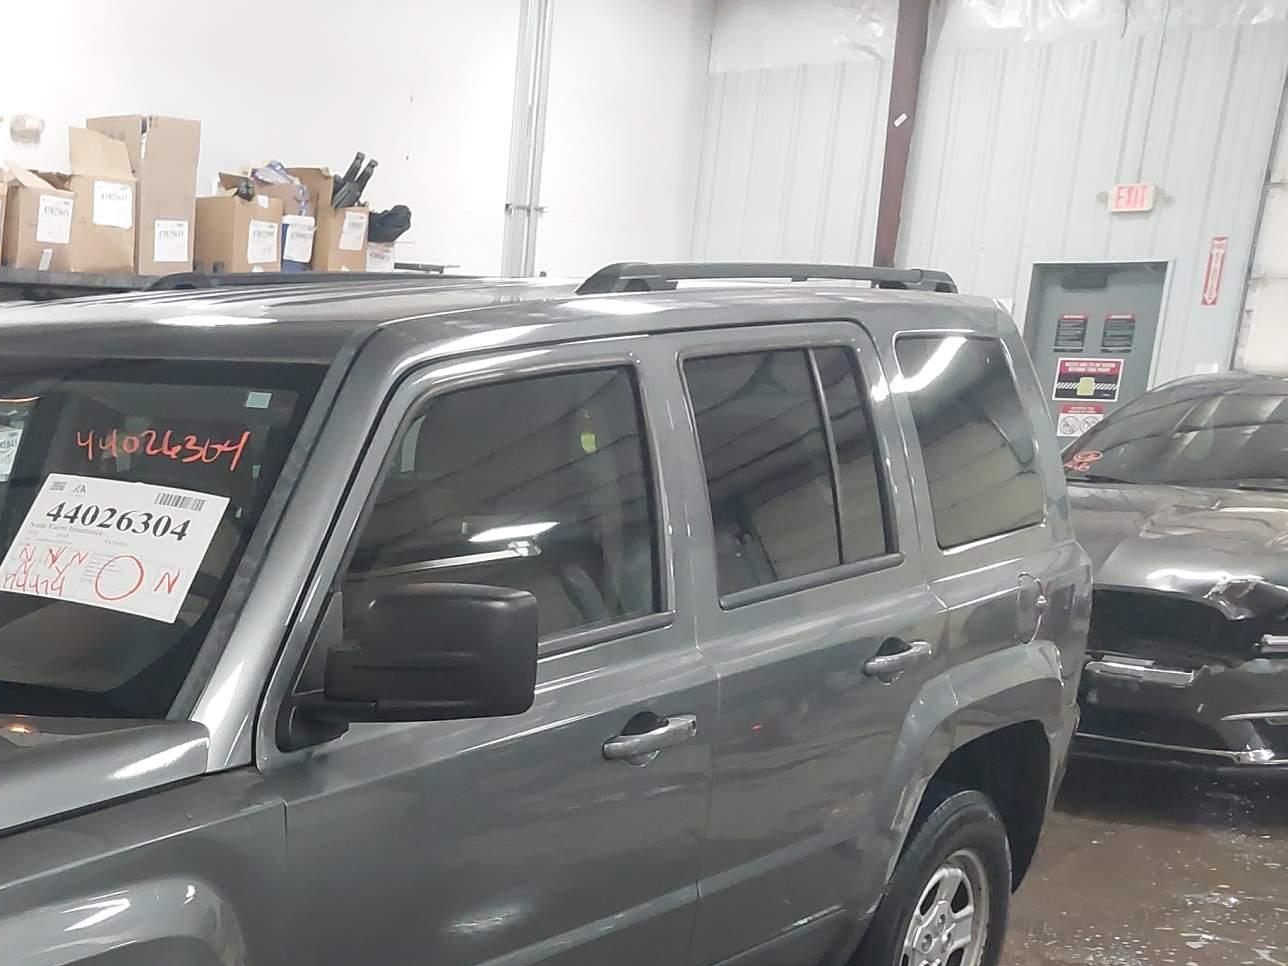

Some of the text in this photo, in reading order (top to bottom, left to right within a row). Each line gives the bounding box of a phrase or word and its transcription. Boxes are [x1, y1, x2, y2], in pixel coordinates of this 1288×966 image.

[1115, 186, 1149, 209] EXIT
[77, 429, 252, 471] 44026304
[46, 502, 192, 542] 44026304
[154, 568, 181, 594] N
